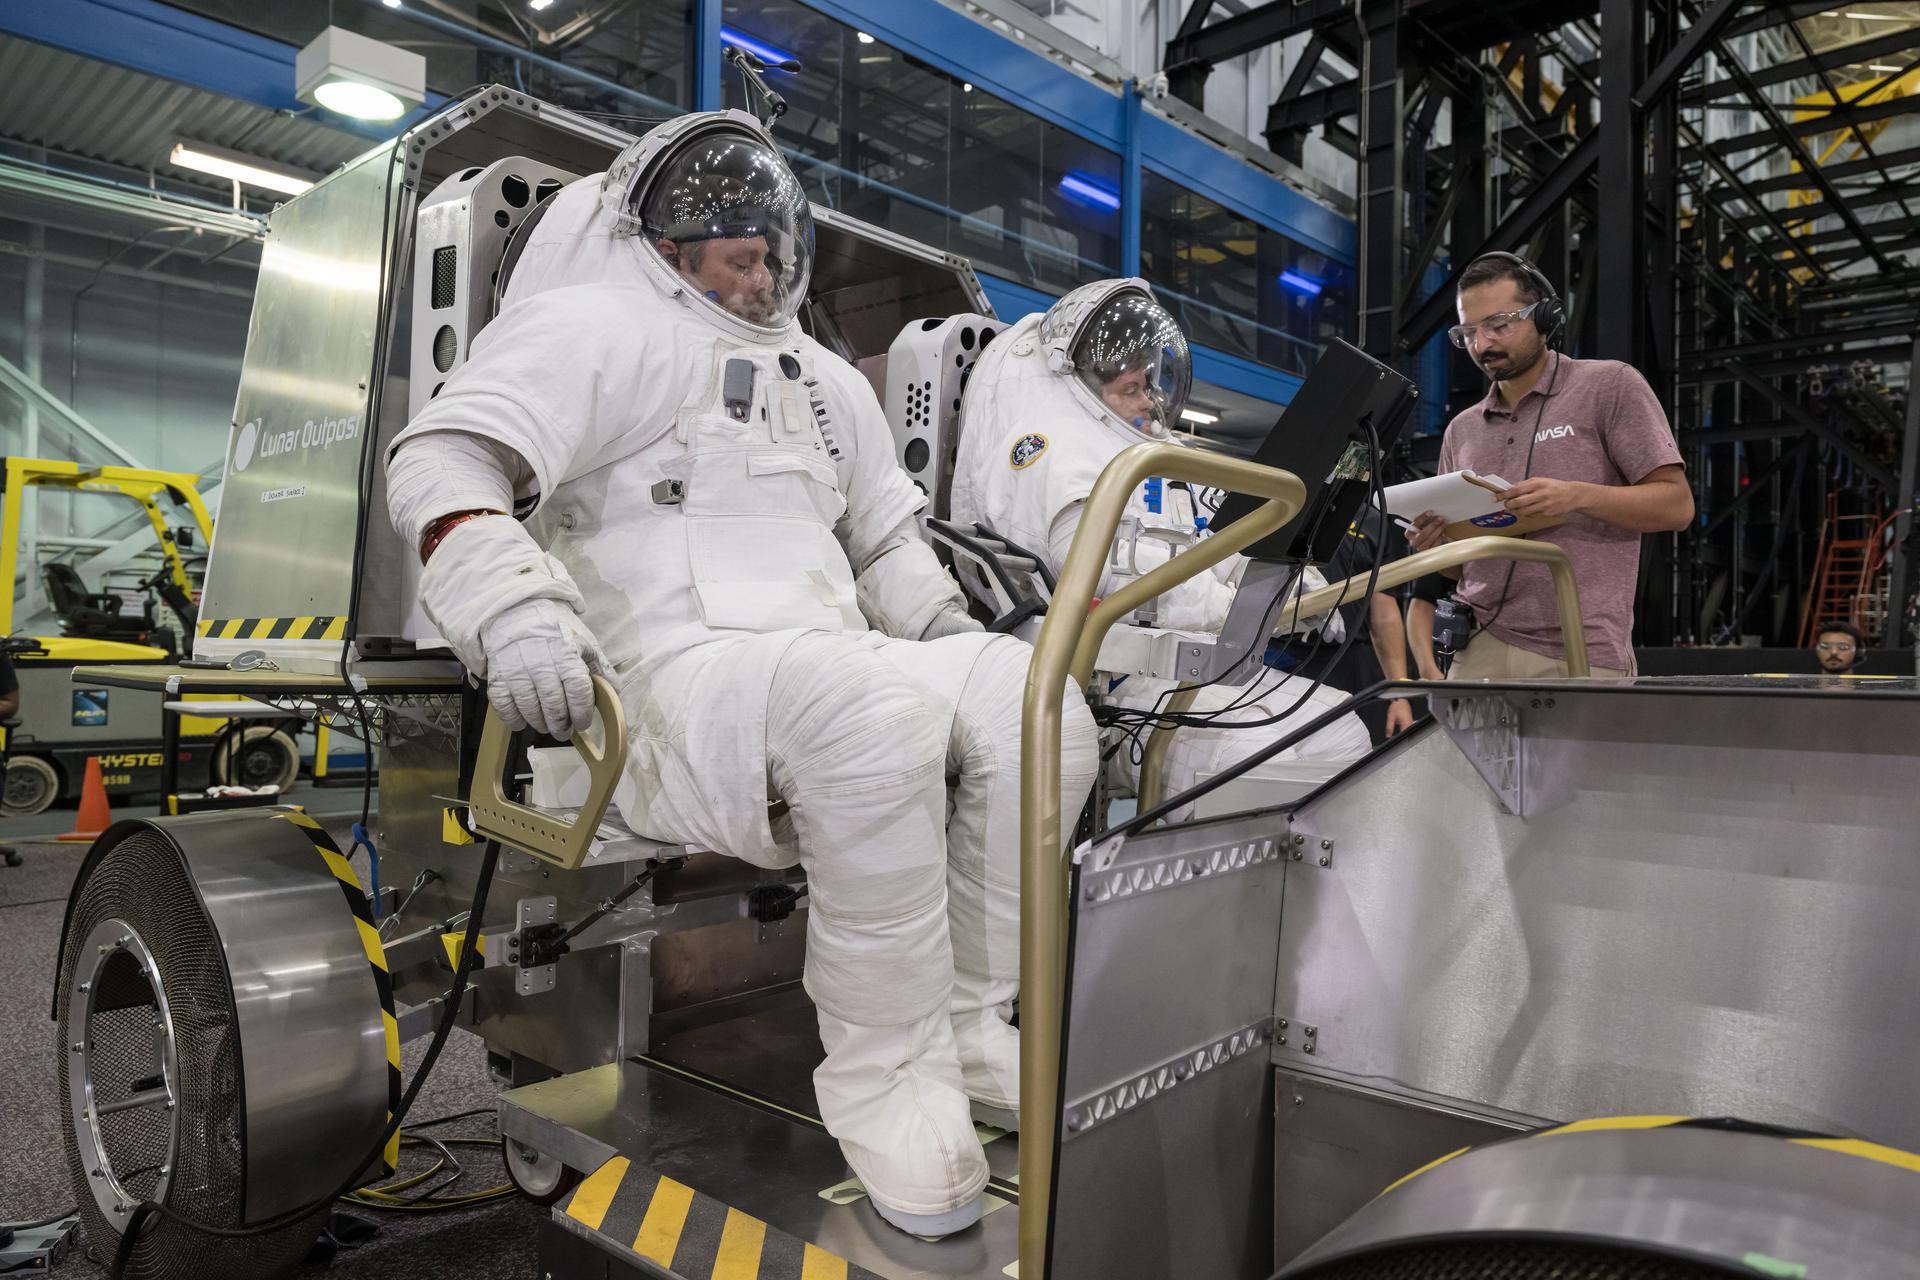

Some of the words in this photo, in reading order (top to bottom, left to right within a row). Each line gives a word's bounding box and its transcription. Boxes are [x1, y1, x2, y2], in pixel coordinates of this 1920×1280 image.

[260, 428, 301, 458] Lunar
[1534, 425, 1575, 443] NASA
[1476, 514, 1512, 526] NASA
